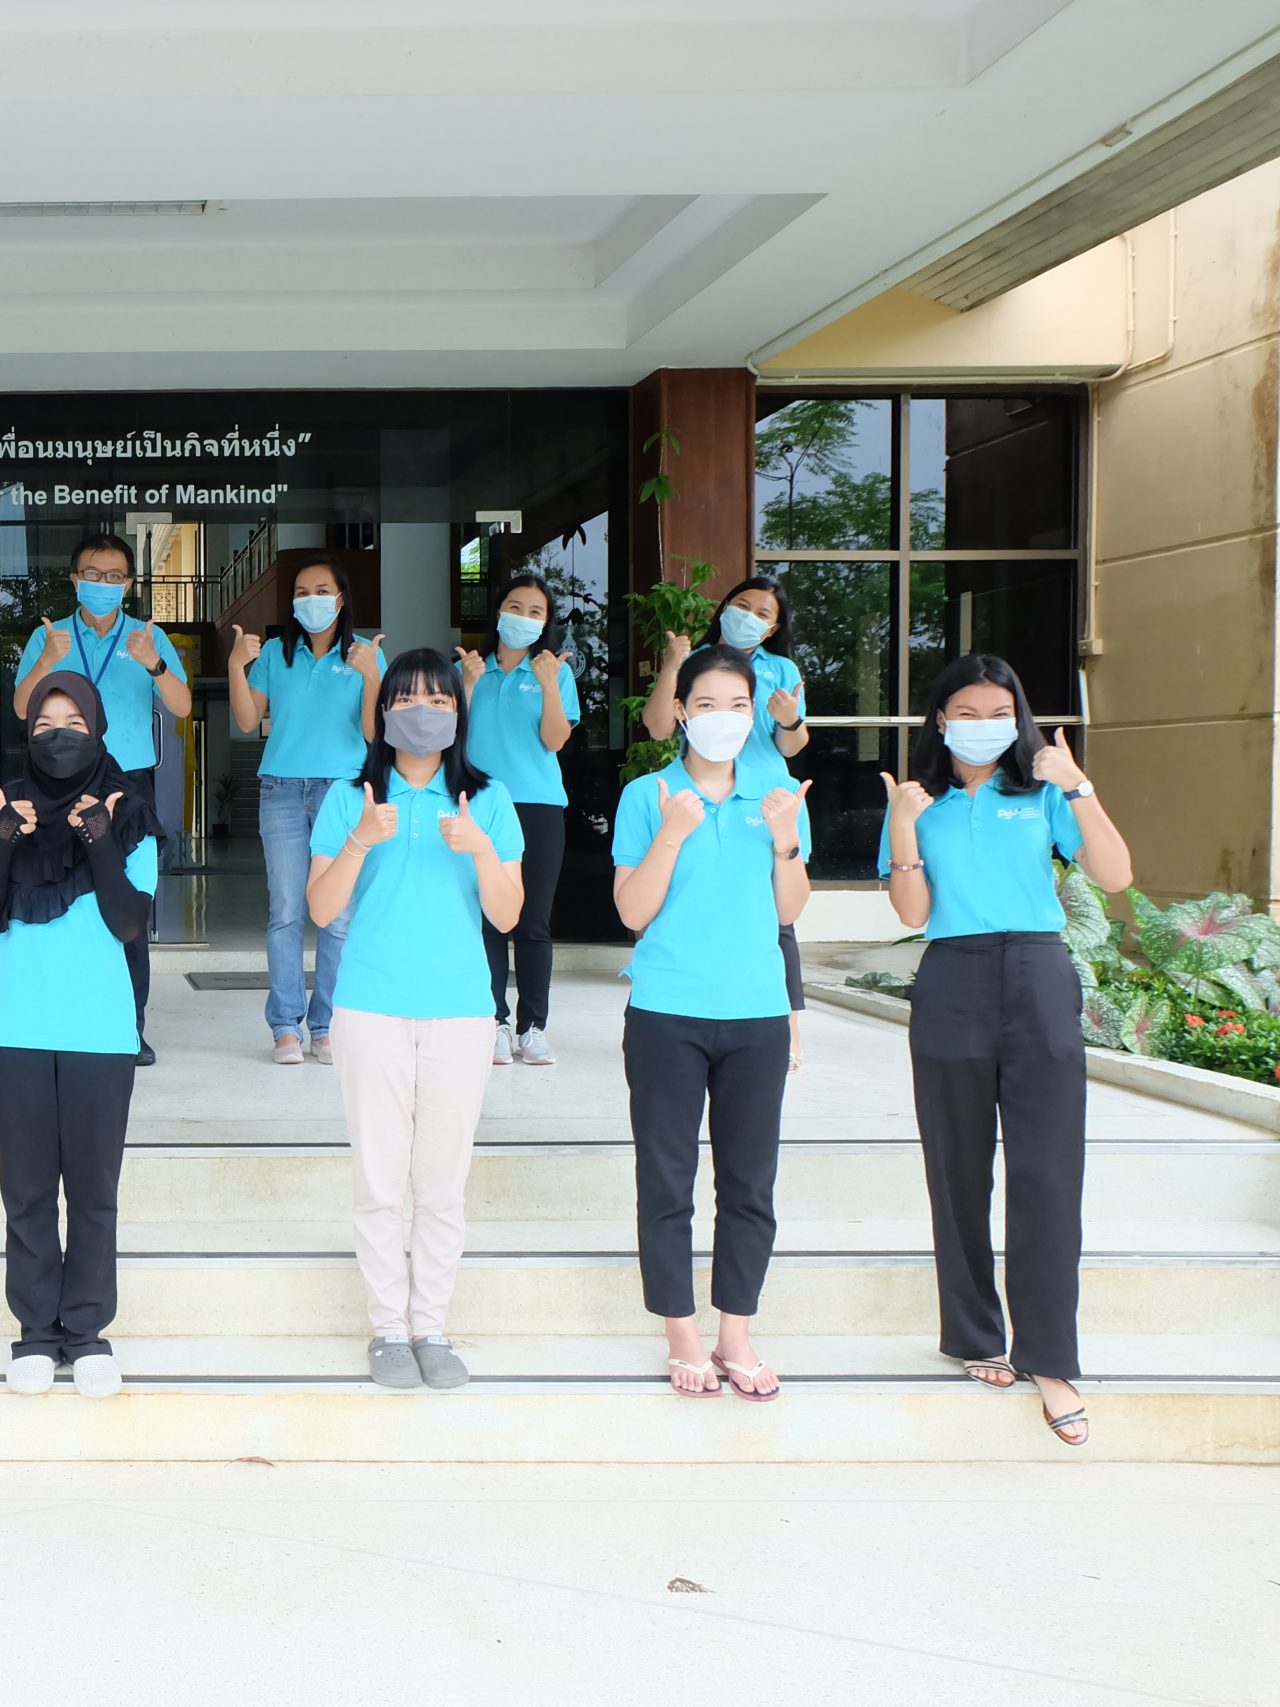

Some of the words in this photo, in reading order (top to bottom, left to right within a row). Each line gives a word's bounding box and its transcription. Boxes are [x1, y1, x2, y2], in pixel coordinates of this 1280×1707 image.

[10, 484, 48, 506] the
[54, 484, 138, 505] Benefit
[144, 484, 170, 505] of
[176, 483, 289, 504] Mankind"
